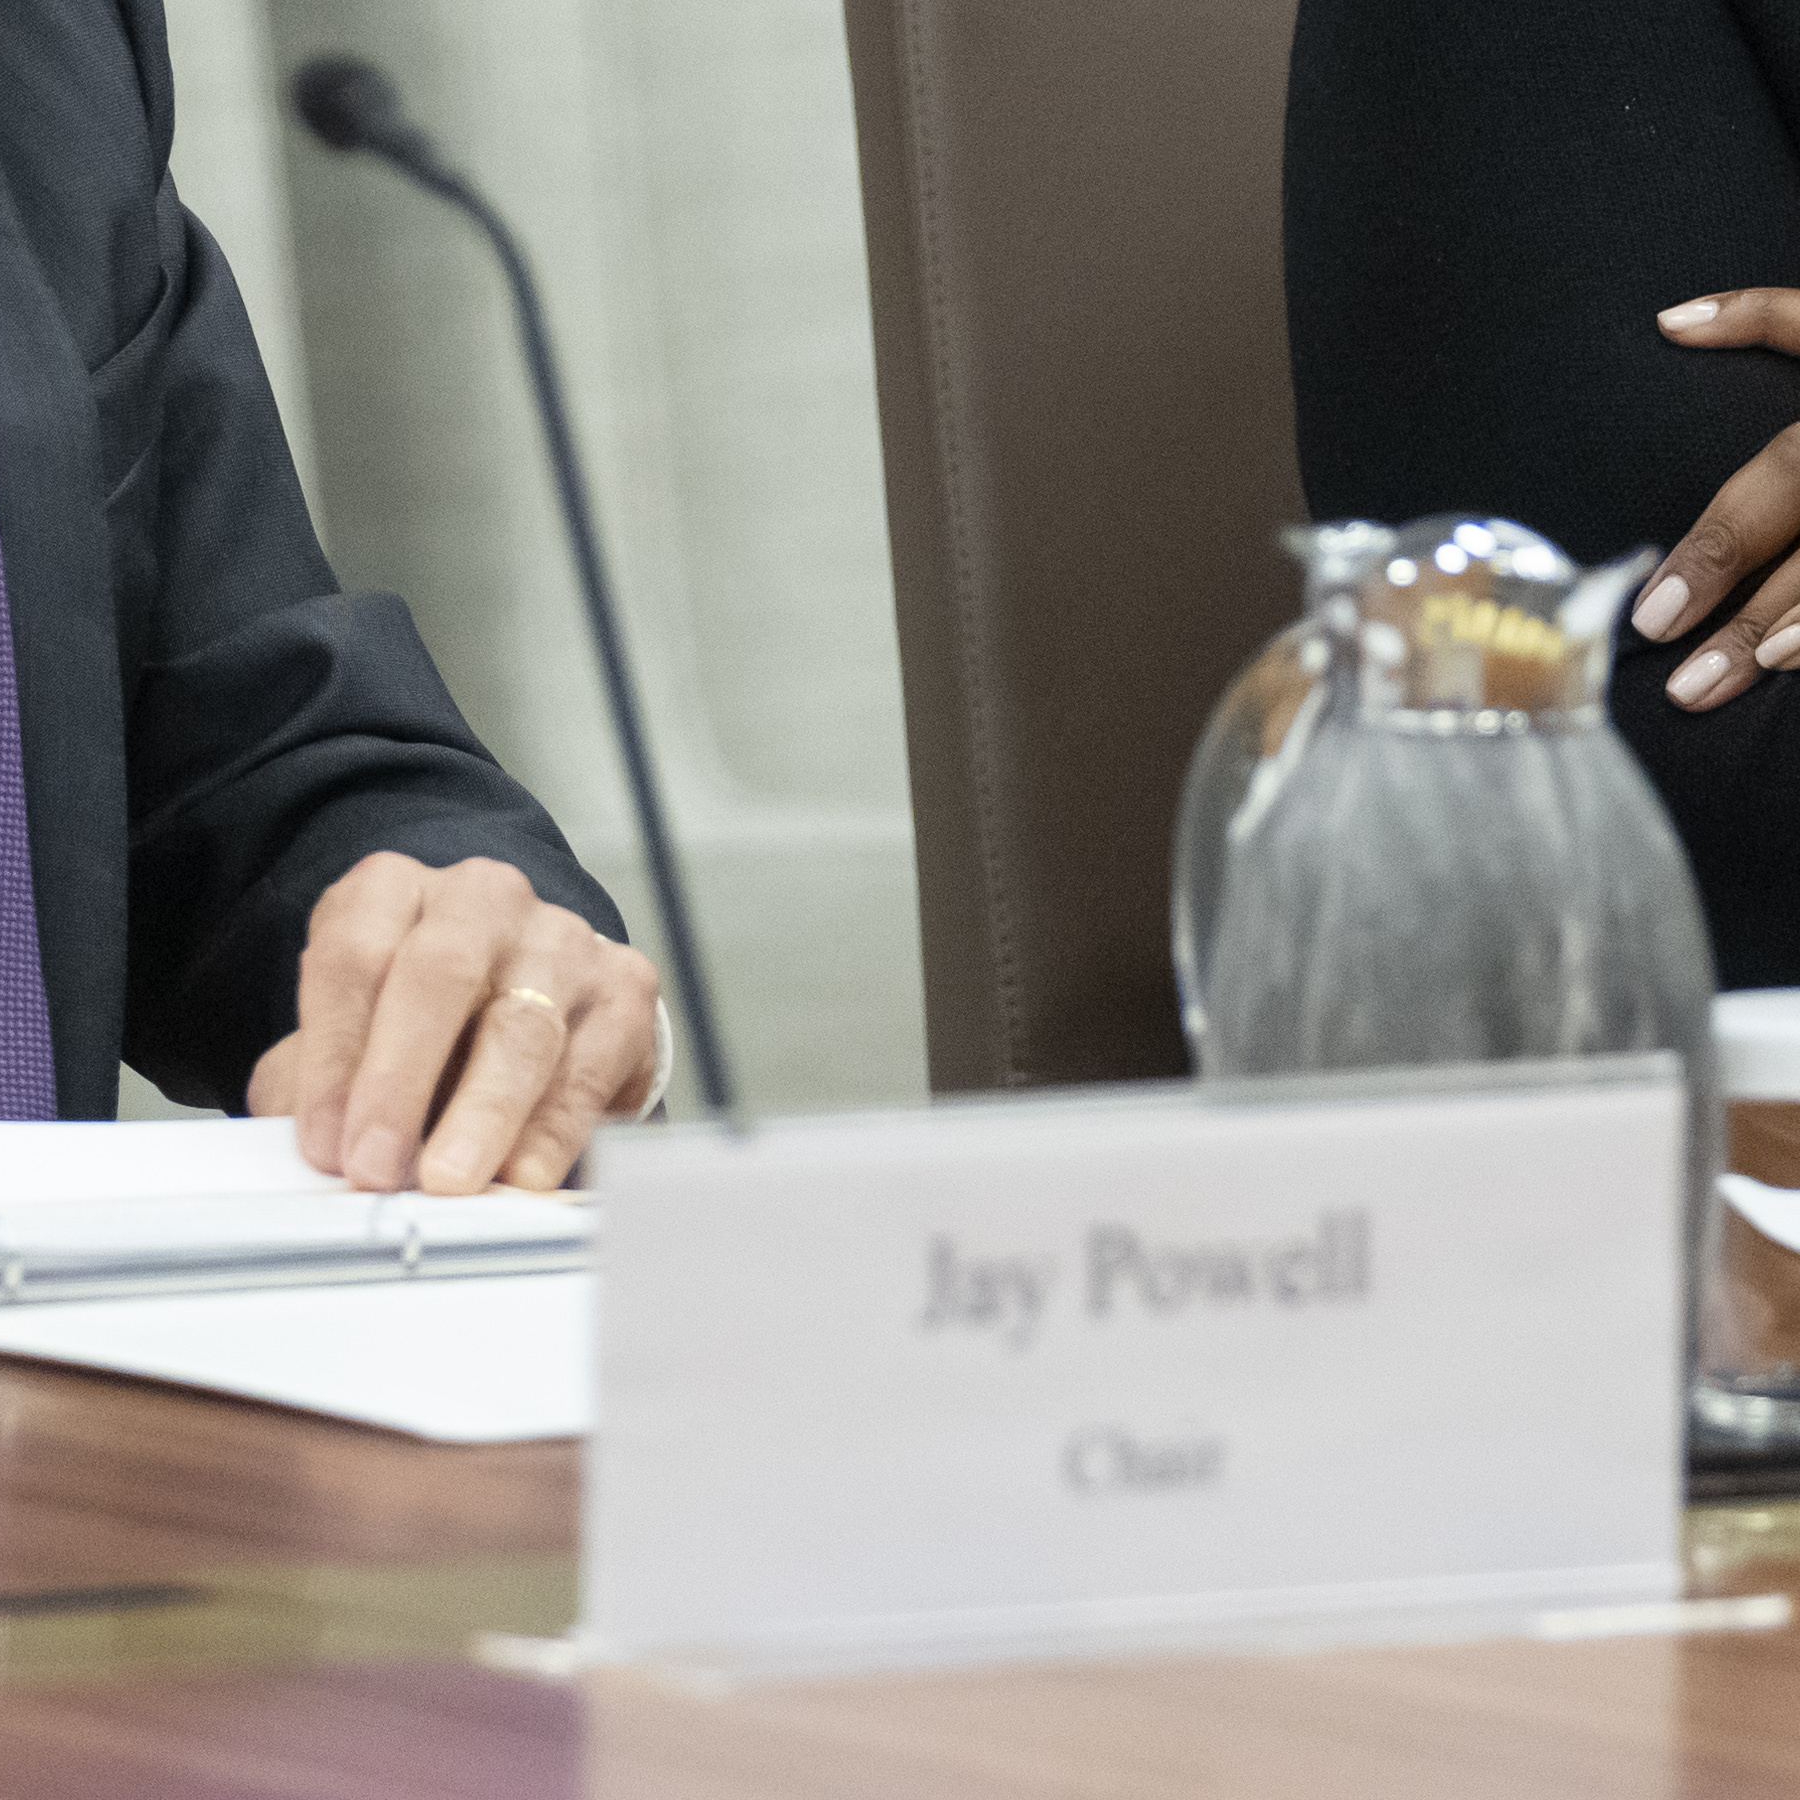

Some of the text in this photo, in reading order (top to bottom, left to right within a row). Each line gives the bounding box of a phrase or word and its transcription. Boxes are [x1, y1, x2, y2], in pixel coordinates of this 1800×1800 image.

[918, 1208, 1374, 1350] Jay Powell
[1060, 1424, 1226, 1497] Chair
